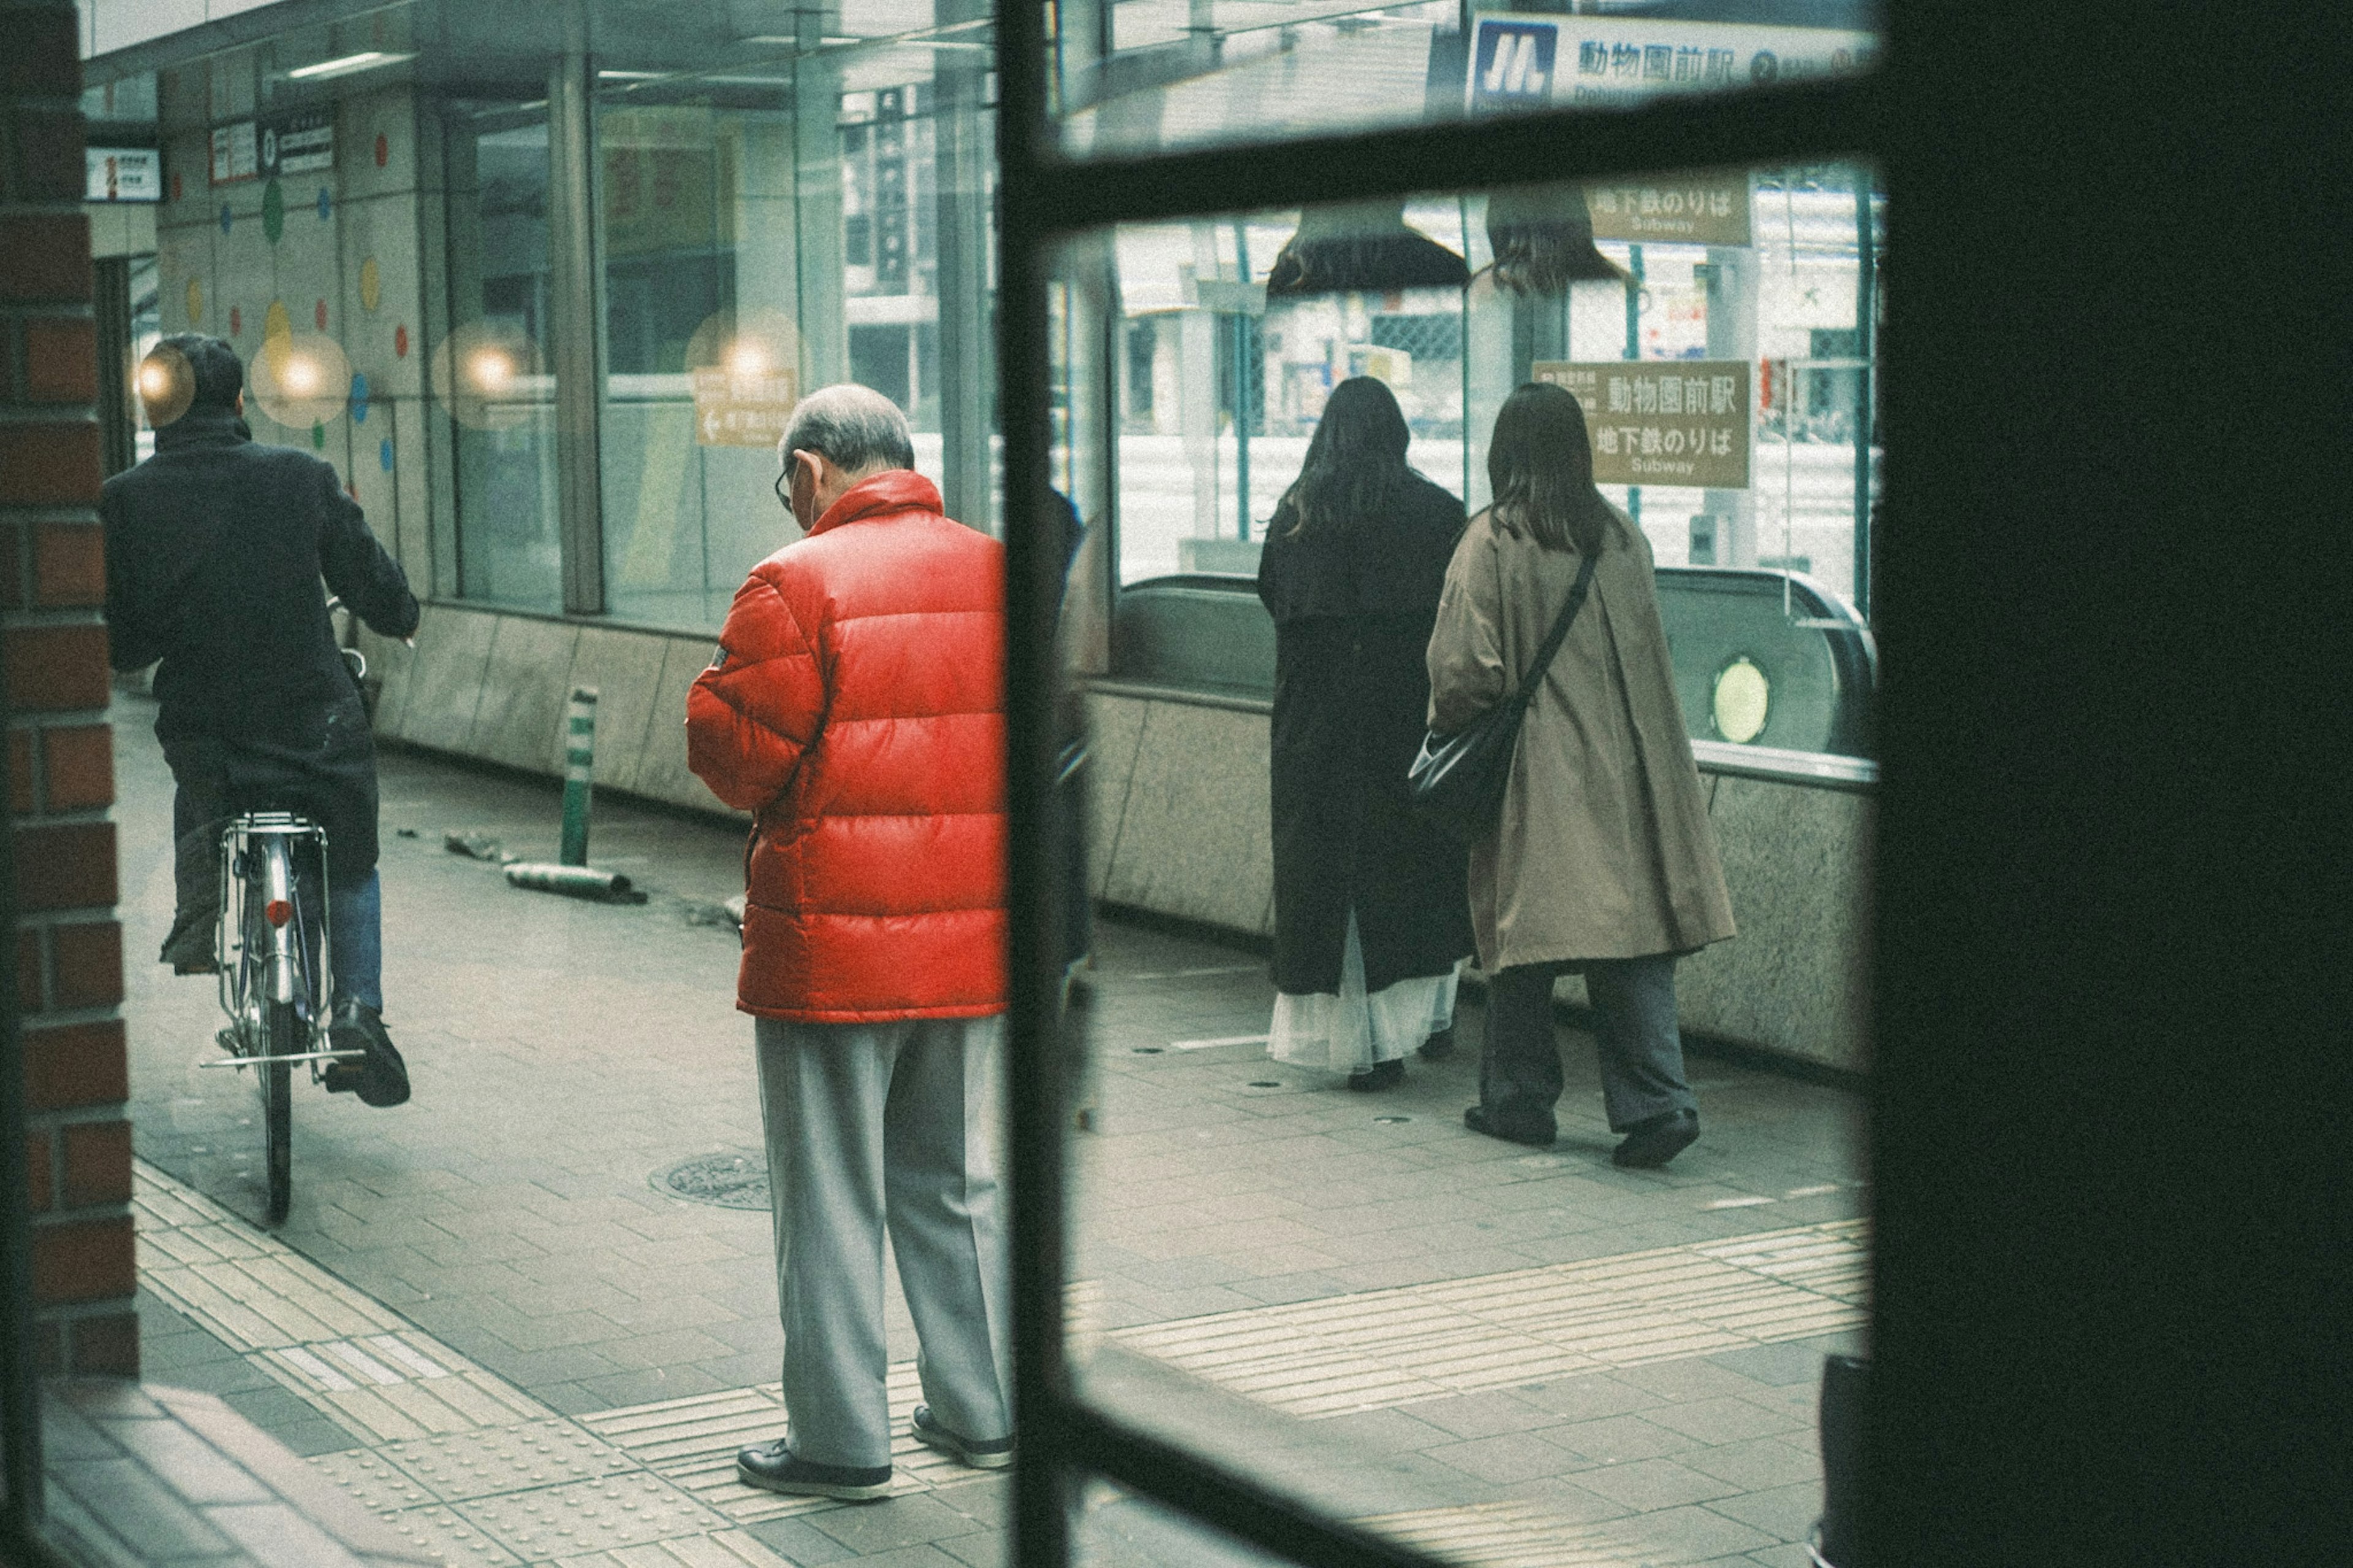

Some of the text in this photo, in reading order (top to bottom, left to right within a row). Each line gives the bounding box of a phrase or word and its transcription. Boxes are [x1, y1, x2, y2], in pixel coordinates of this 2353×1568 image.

[1579, 40, 1733, 82] 動物園前駅
[1632, 216, 1694, 233] Subway
[1608, 376, 1736, 414] 動物園前駅
[1597, 426, 1732, 455] 地下鉄のりば
[1632, 458, 1694, 475] Subway
